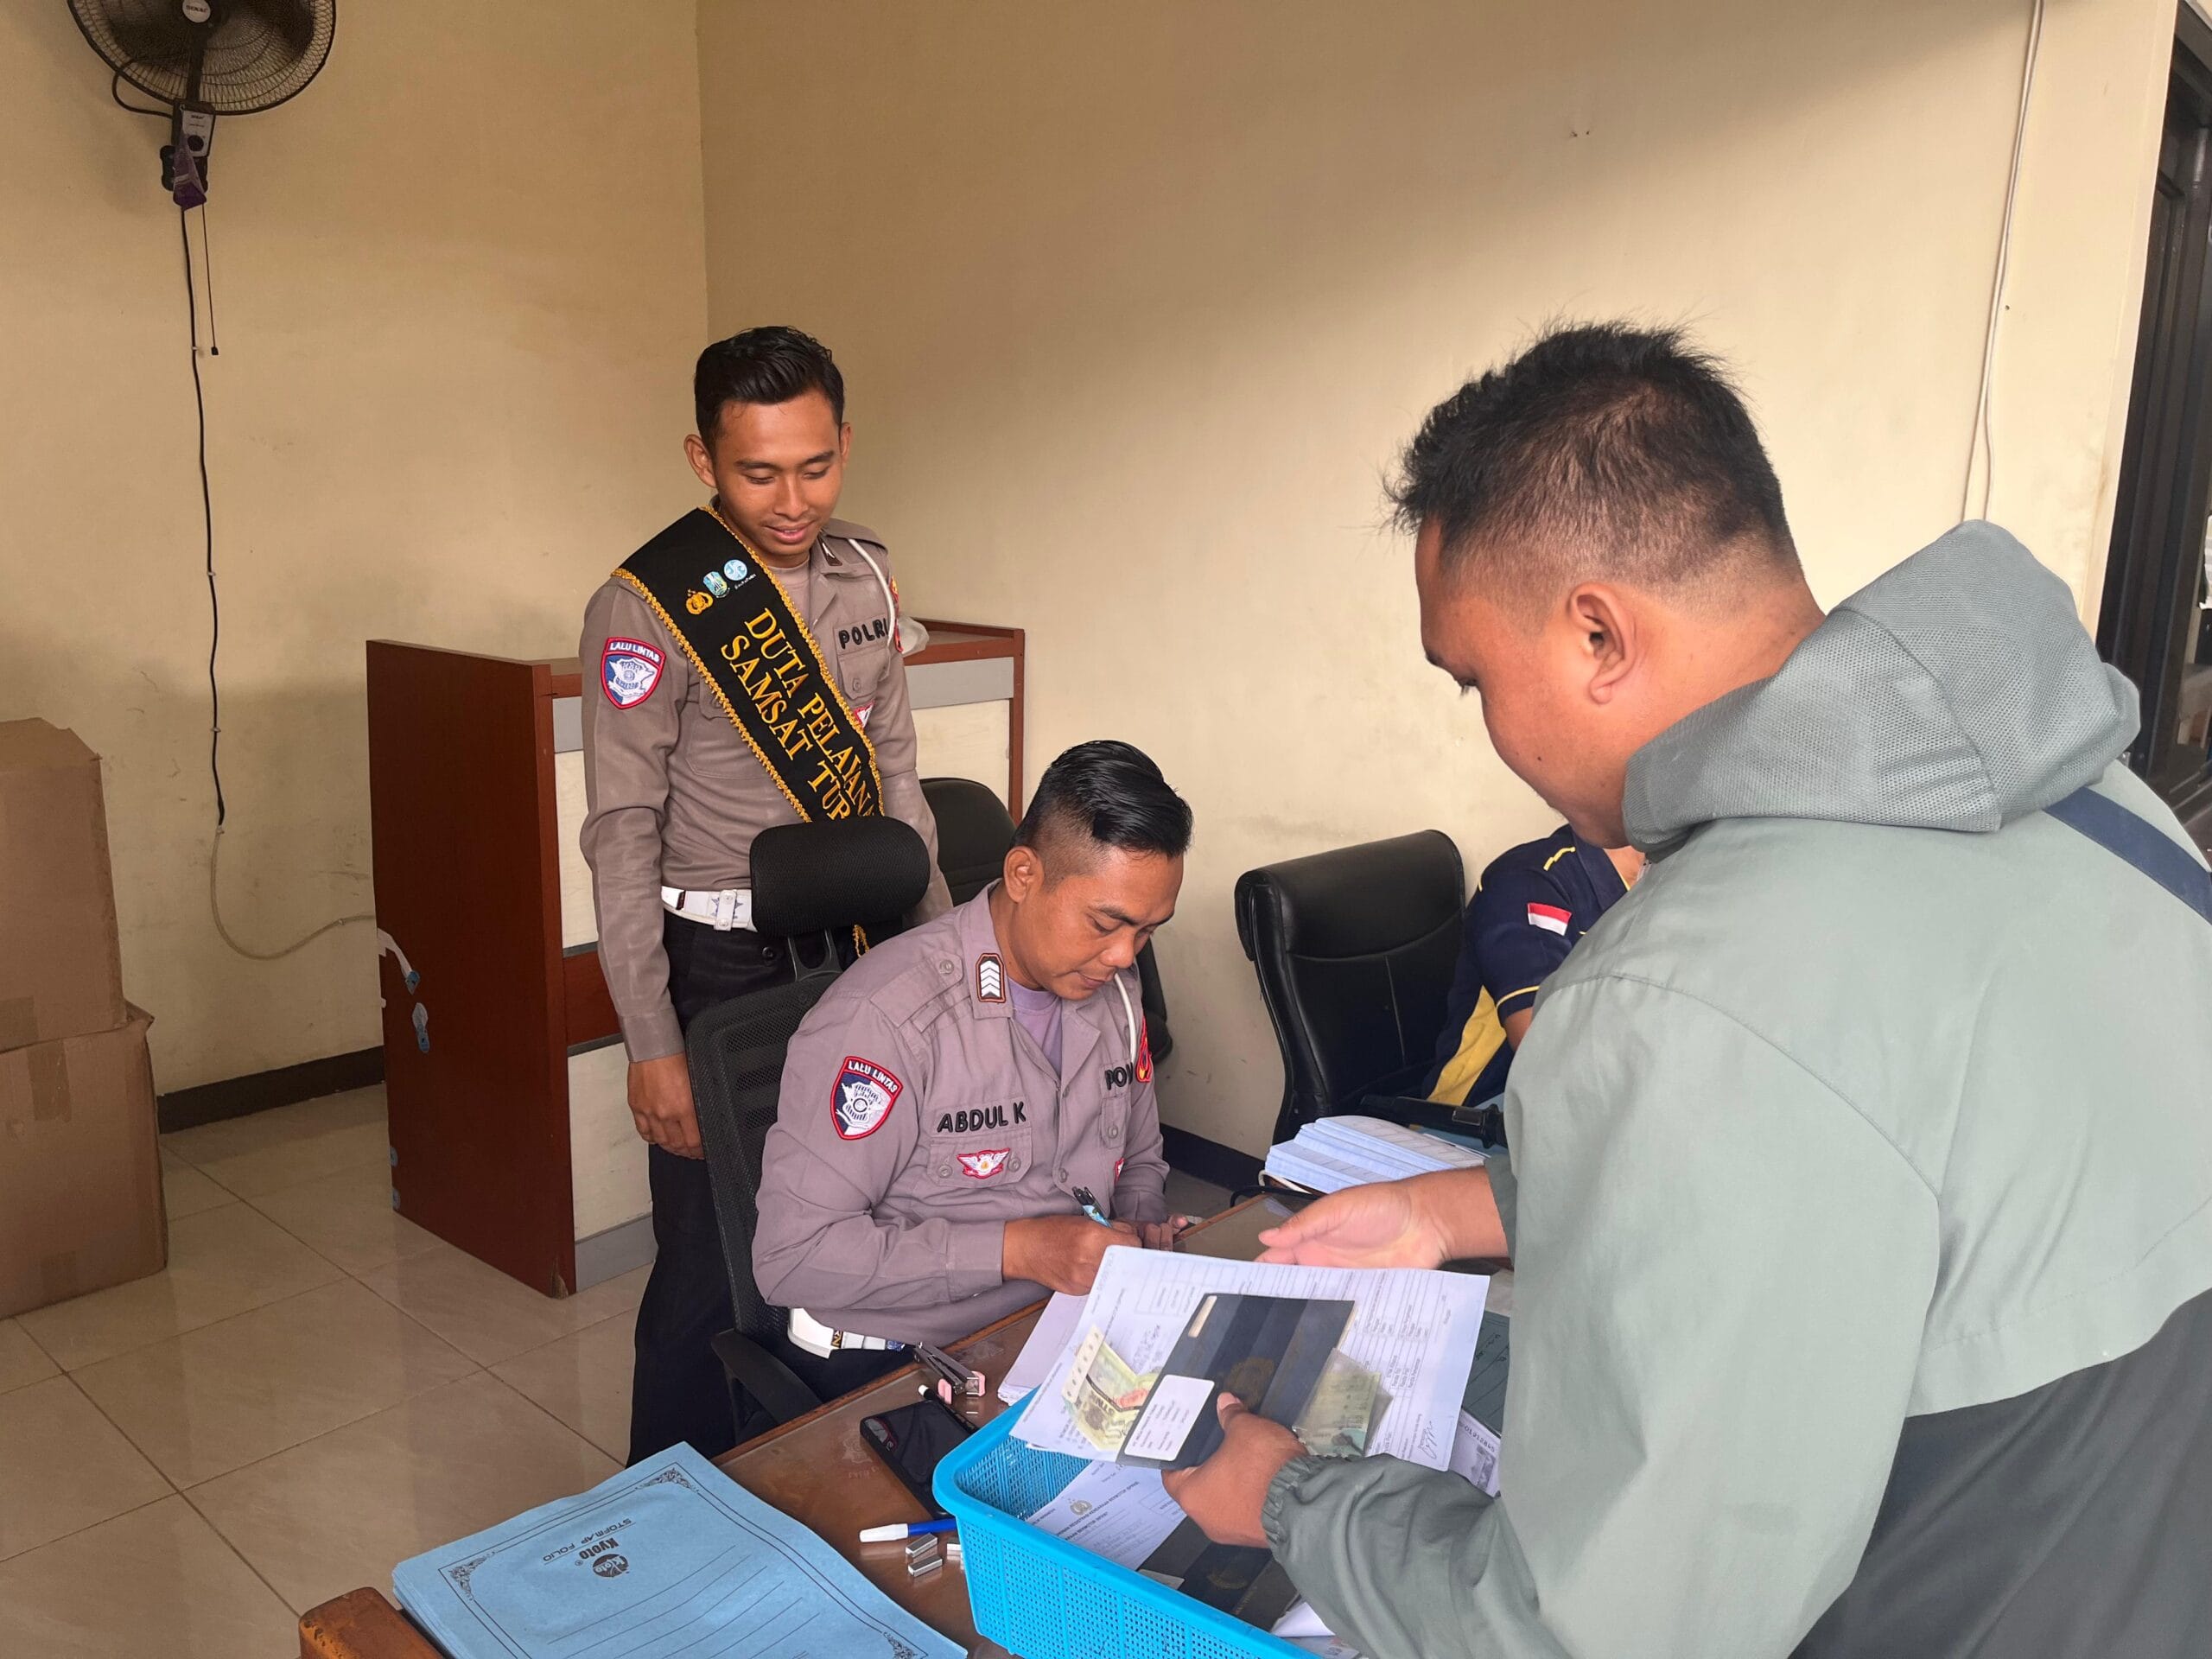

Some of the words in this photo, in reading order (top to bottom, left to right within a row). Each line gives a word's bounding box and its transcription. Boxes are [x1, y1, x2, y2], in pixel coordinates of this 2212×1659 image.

[838, 617, 889, 650] POLRI
[609, 641, 632, 652] LALU
[632, 644, 661, 663] LINTAS
[744, 607, 809, 699] DUTA
[721, 635, 813, 761] SAMSAT
[848, 1060, 872, 1075] LALU
[872, 1069, 899, 1093] LINTAS
[937, 1104, 1009, 1133] ABDUL
[1013, 1101, 1027, 1125] K
[543, 1542, 576, 1561] FOLIO
